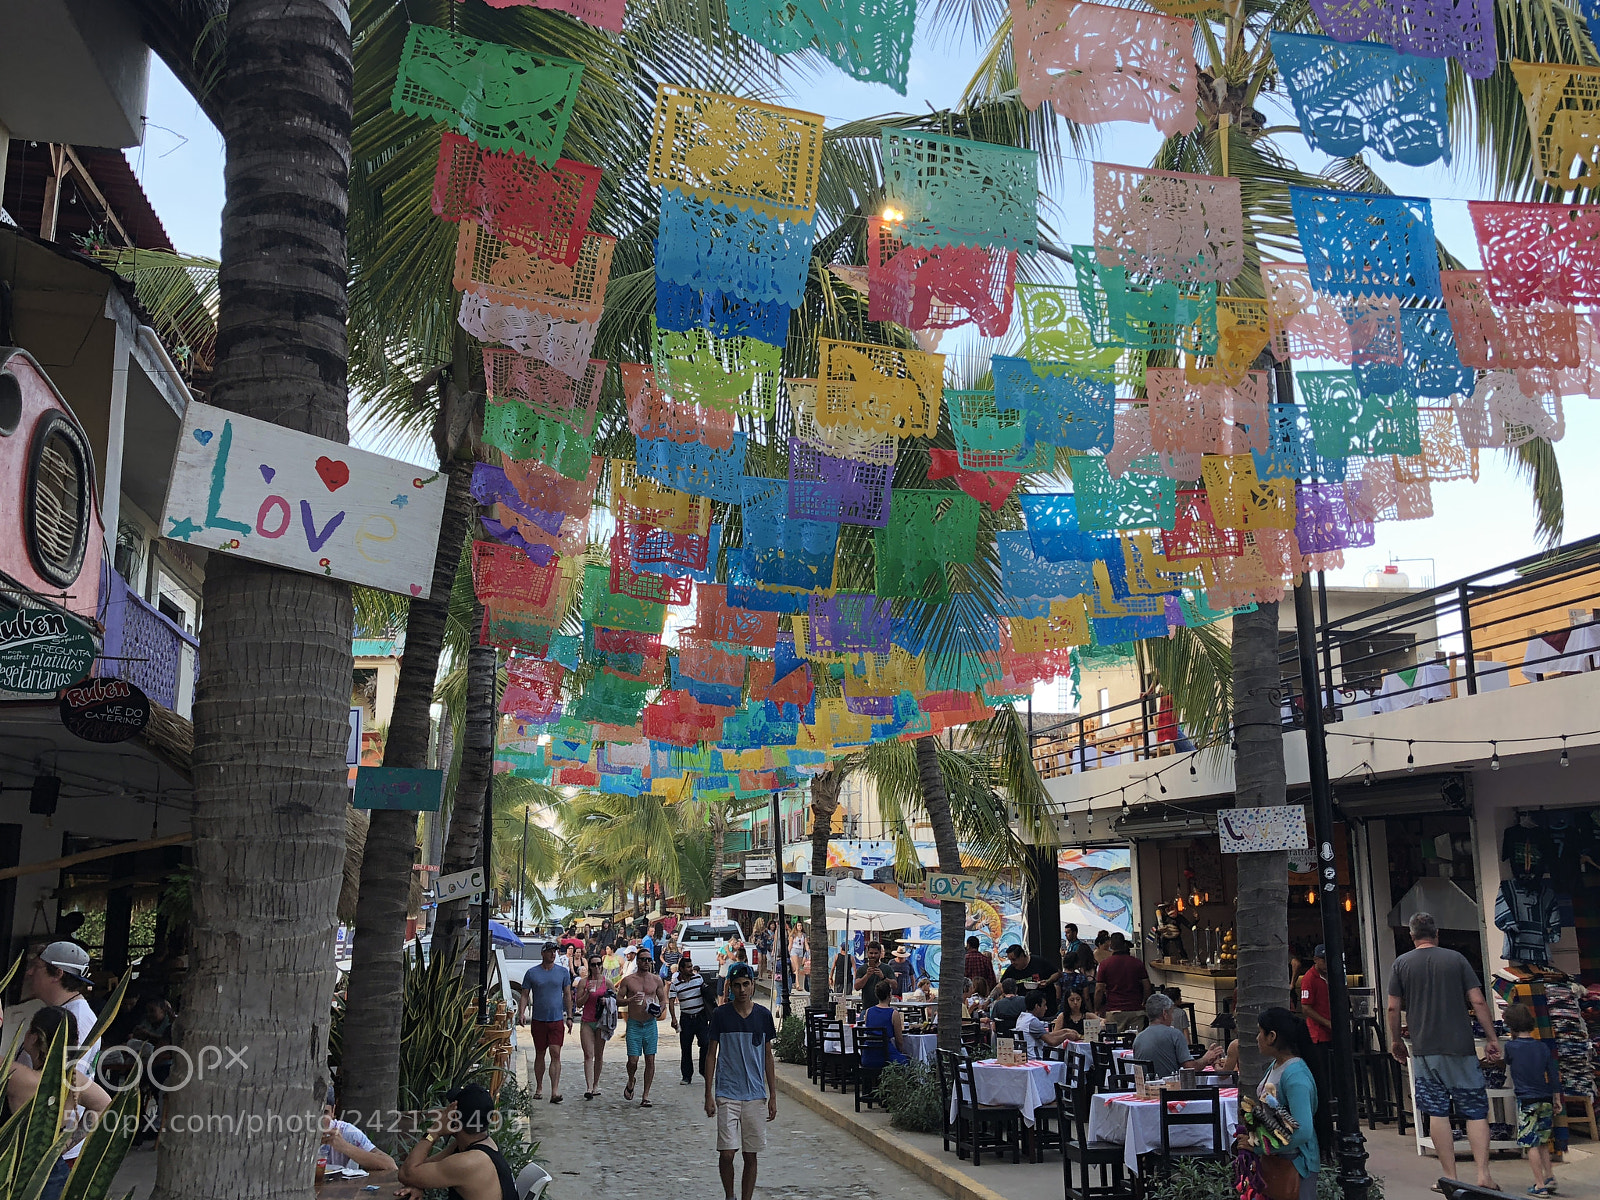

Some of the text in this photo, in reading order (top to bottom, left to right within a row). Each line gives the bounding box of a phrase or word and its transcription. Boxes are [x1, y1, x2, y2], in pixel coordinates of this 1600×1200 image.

[32, 643, 92, 658] PREGUNTA
[31, 653, 85, 672] platillos
[0, 662, 72, 690] egetarianos
[67, 679, 131, 707] Ruben
[84, 711, 142, 726] CATERING
[106, 705, 143, 718] WE DO
[929, 877, 977, 900] LOVE
